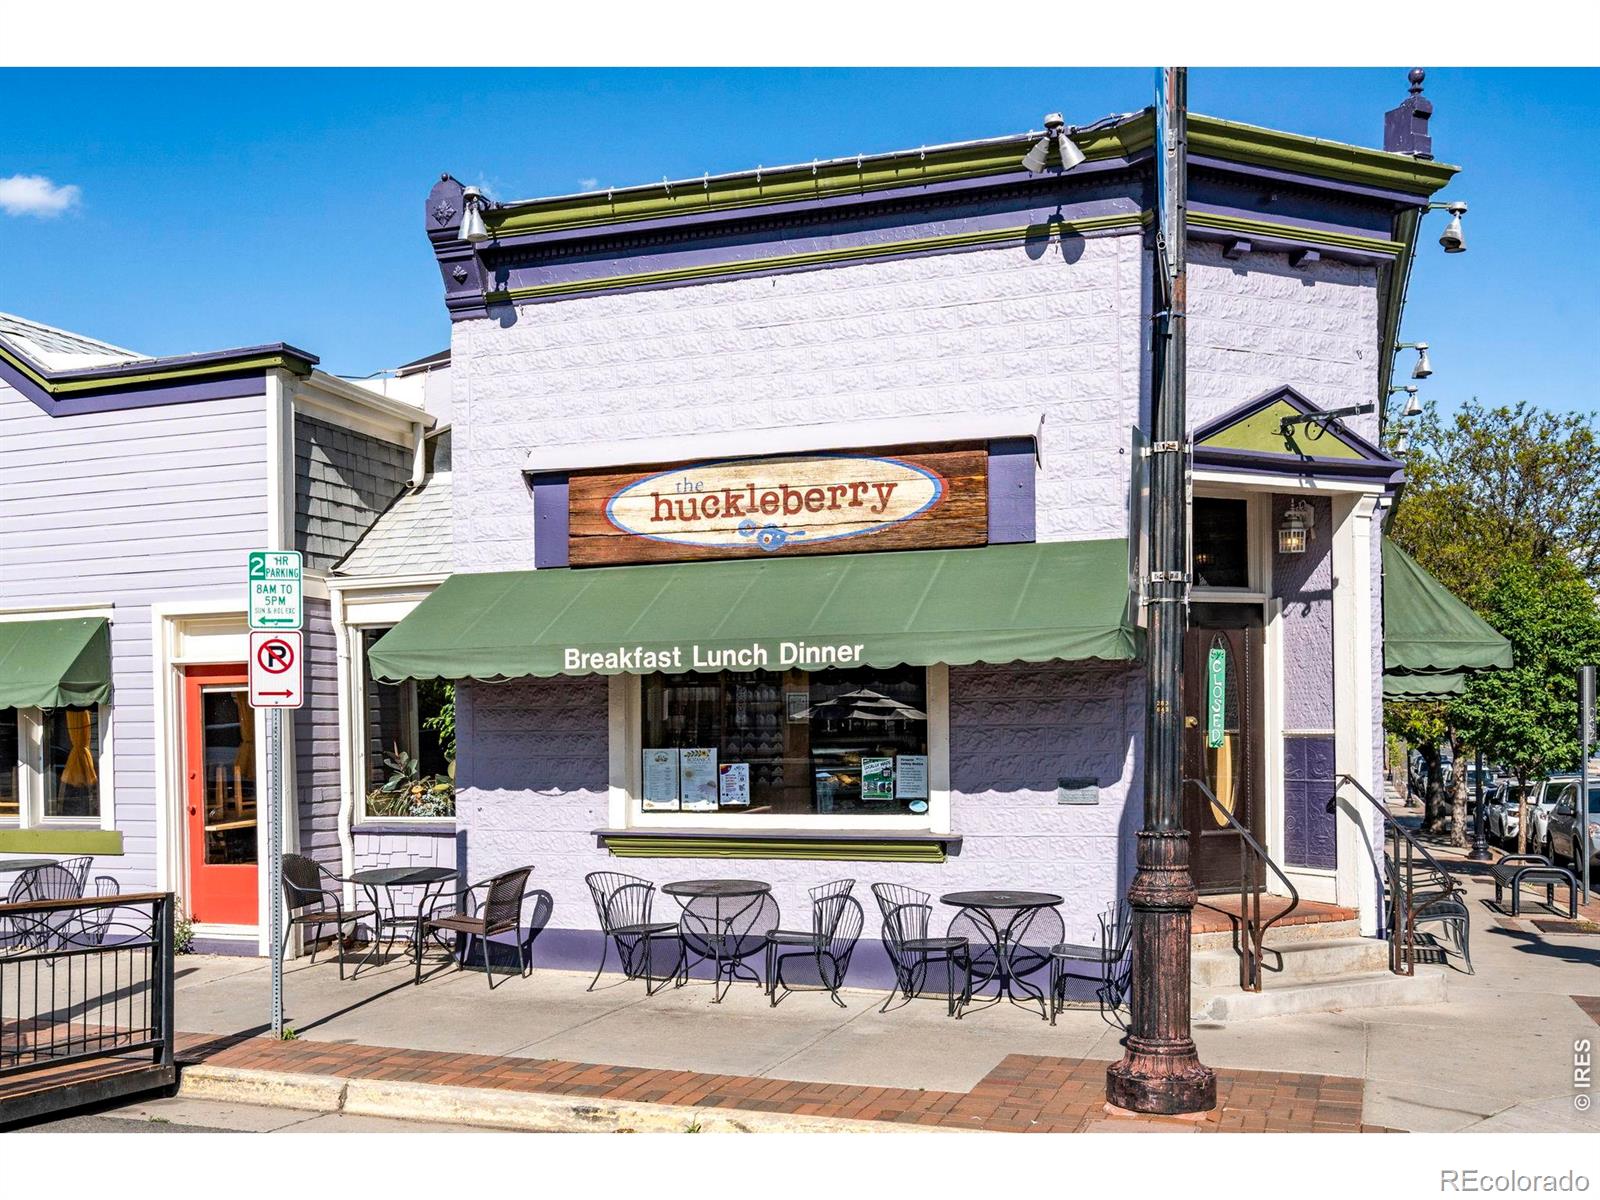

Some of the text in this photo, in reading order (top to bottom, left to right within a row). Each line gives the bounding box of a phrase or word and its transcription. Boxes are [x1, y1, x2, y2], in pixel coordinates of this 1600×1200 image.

[675, 477, 704, 494] the
[650, 481, 898, 522] huckleberry
[250, 556, 264, 576] 2
[275, 556, 289, 566] HR
[265, 567, 299, 578] PARKING
[256, 584, 293, 594] 8AM TO
[265, 595, 286, 606] 5PM
[564, 641, 864, 670] Breakfast Lunch Dinner
[1212, 659, 1222, 742] CLOSED
